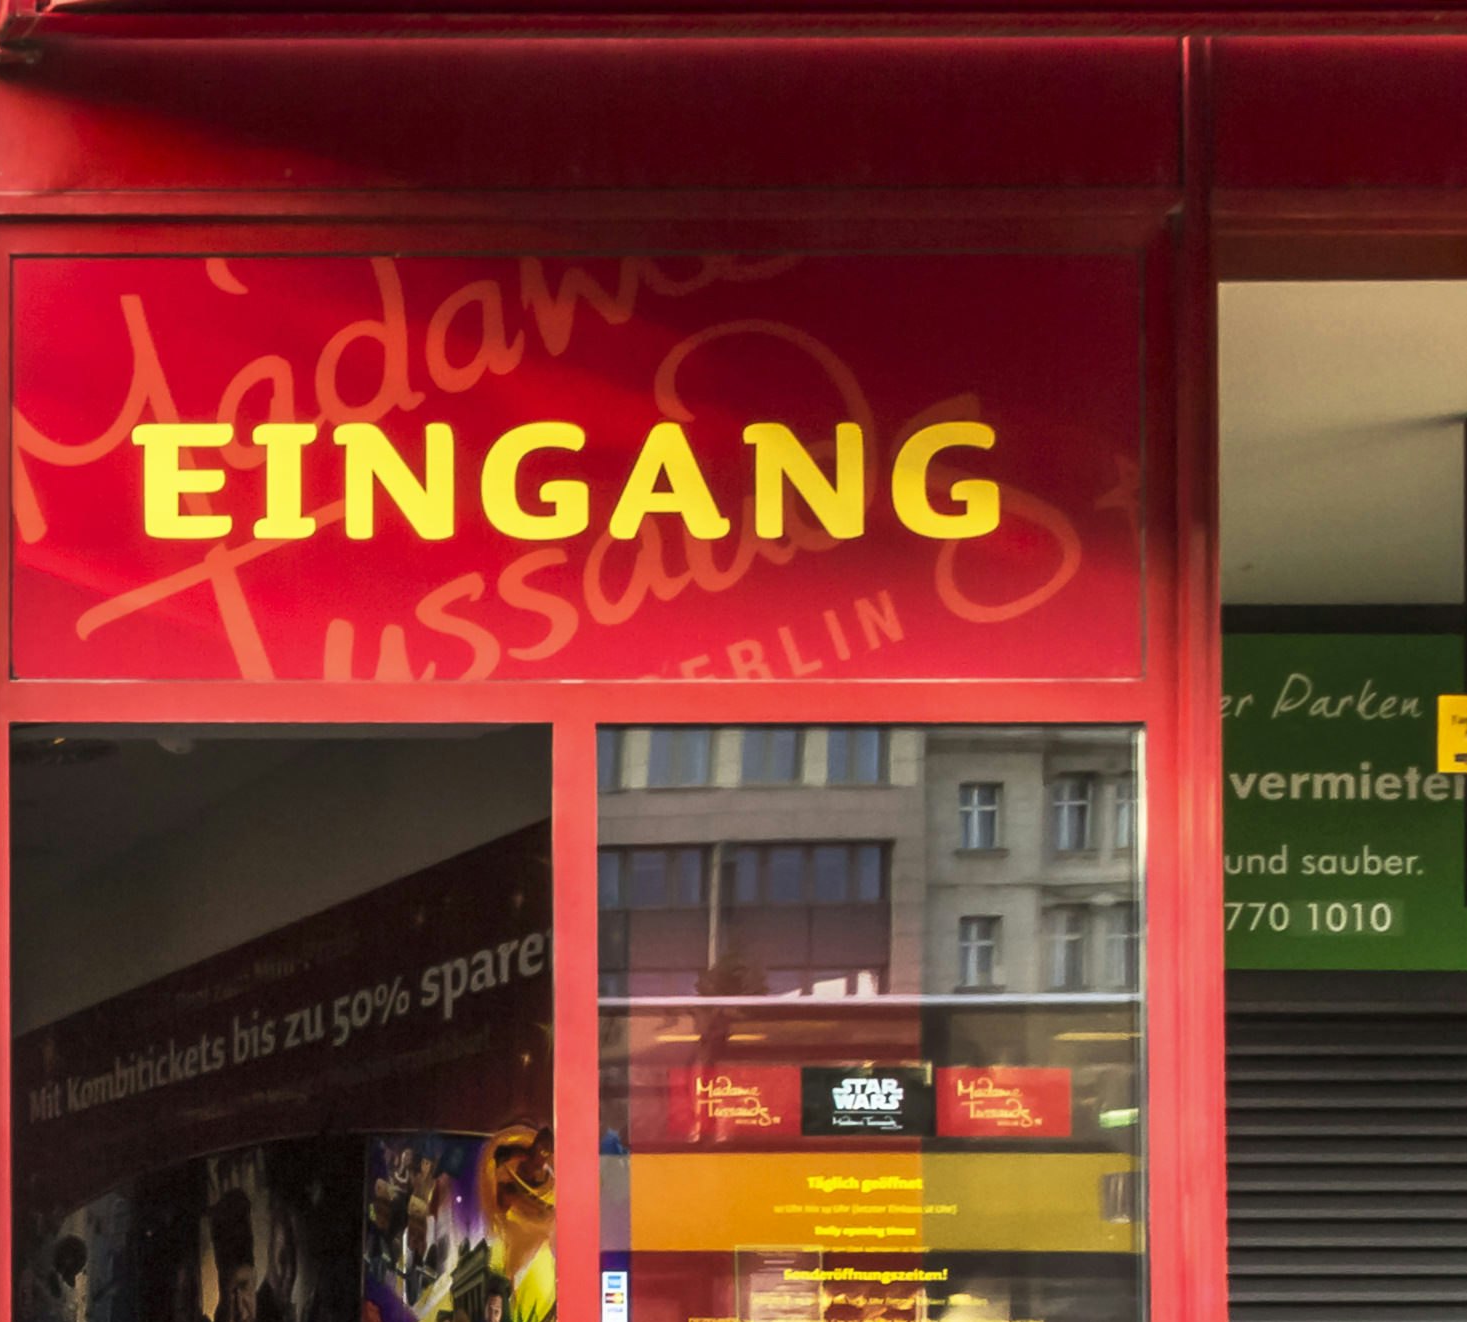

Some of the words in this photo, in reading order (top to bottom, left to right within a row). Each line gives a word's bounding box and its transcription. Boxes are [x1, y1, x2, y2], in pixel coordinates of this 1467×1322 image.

[130, 421, 1000, 540] EINGANG
[640, 589, 906, 680] ERLIN
[1271, 673, 1423, 719] Parken
[1223, 845, 1288, 875] und
[1301, 845, 1424, 875] sauber.
[1306, 903, 1392, 932] 1010
[28, 1086, 63, 1123] Mit
[65, 1033, 225, 1110] Kombitickets
[233, 1010, 275, 1065] bis
[283, 1006, 324, 1049] zu
[332, 977, 409, 1047] 50%
[419, 926, 554, 1020] spare
[833, 1078, 903, 1095] STAR
[833, 1093, 903, 1110] WARS
[783, 1268, 948, 1284] Sonderöffnungszeiten!
